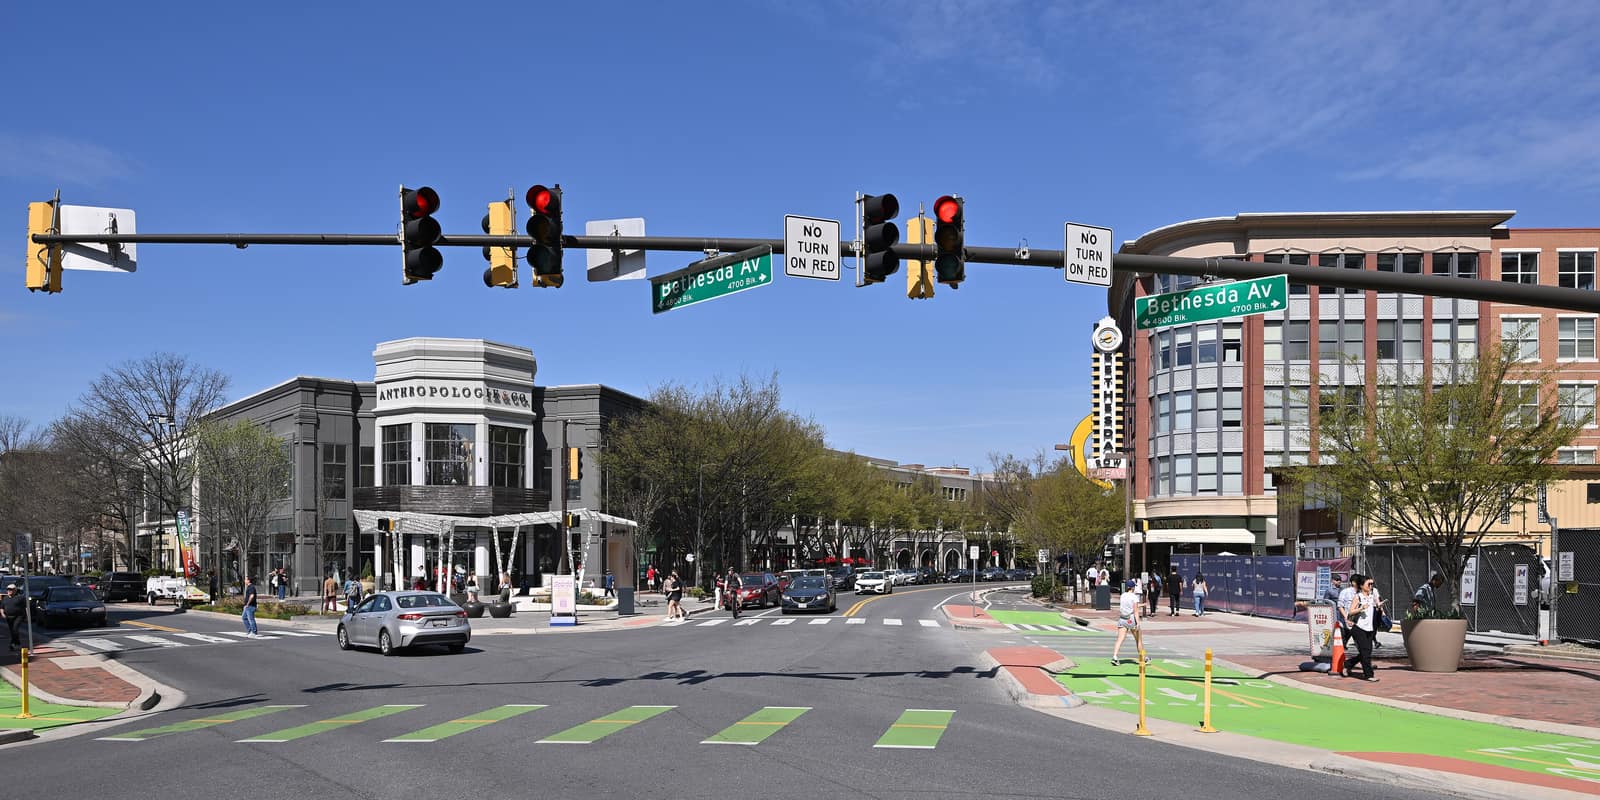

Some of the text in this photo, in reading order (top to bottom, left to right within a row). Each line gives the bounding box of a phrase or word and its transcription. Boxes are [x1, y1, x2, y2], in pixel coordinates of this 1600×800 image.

[803, 224, 822, 238] NO
[1081, 232, 1097, 245] NO
[798, 241, 829, 255] TURN
[1076, 247, 1103, 262] TURN
[790, 256, 835, 273] ON RED
[1070, 263, 1108, 279] ON RED
[661, 257, 761, 297] Bethesda Av
[728, 279, 744, 290] 4700
[665, 295, 682, 306] 4800
[1148, 281, 1273, 316] Bethesda Av
[1231, 301, 1269, 314] 4700 Blk.
[1152, 313, 1188, 326] 4800 Blk.
[379, 386, 500, 402] ANTHROPOLOGIE
[1104, 352, 1113, 450] BETHESDA
[1095, 459, 1121, 468] ROW
